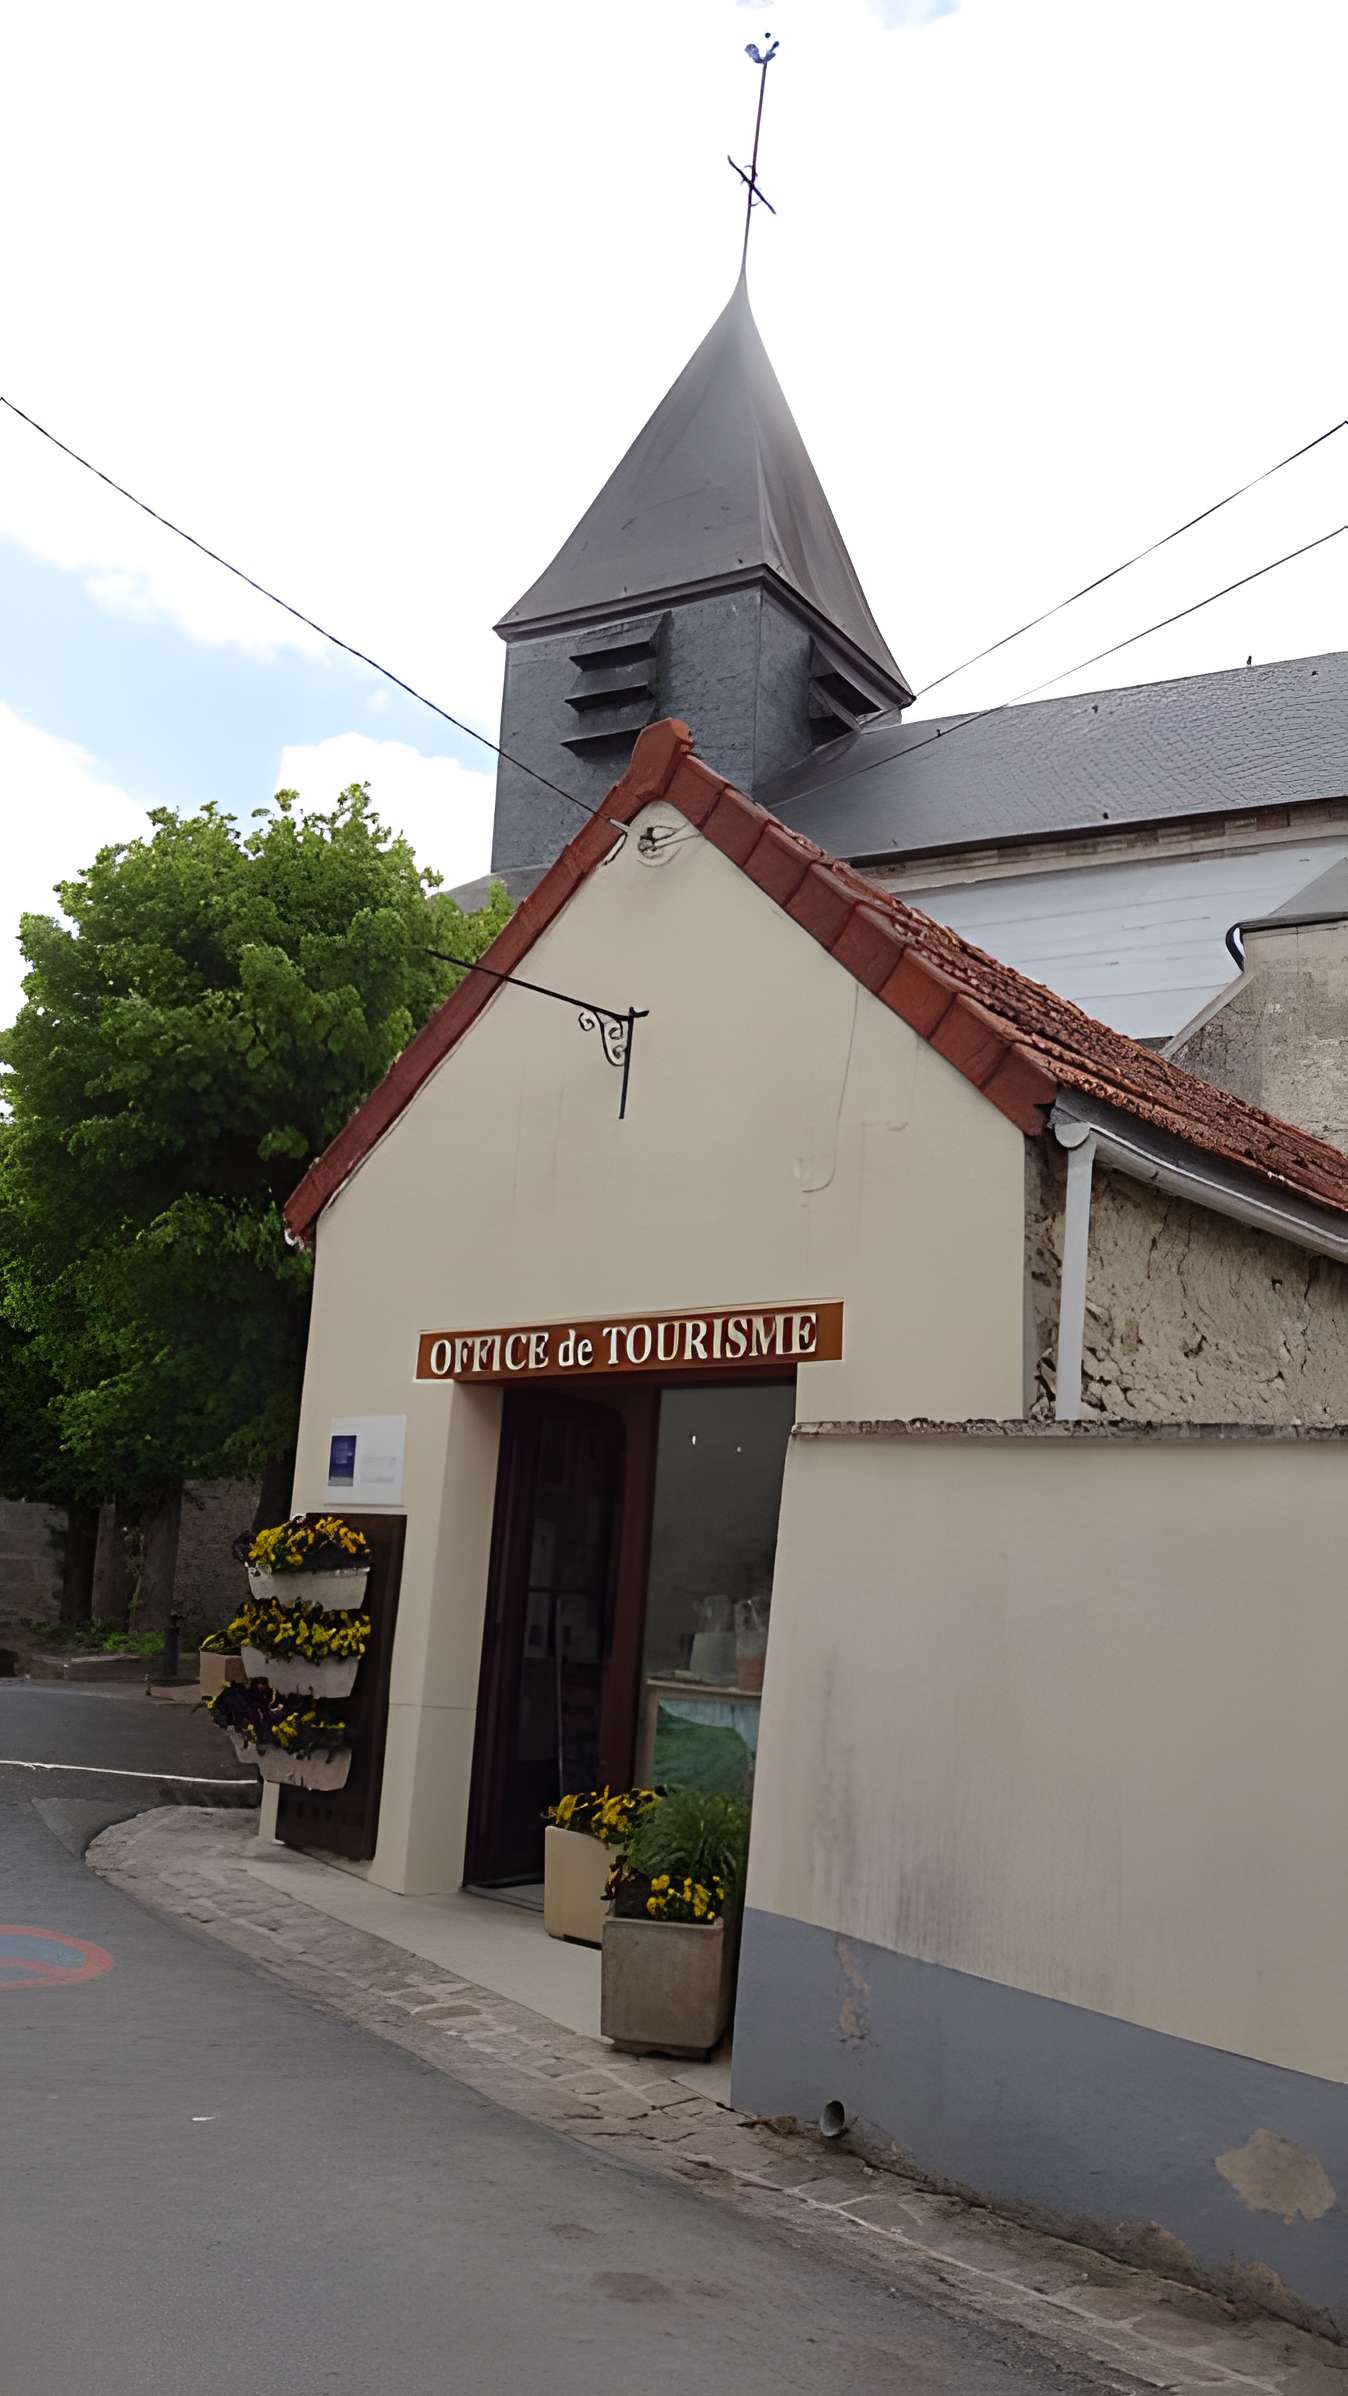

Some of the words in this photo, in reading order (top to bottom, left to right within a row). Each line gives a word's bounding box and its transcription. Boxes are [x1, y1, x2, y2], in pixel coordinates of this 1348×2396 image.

[429, 1331, 549, 1376] OFFICE
[558, 1328, 594, 1367] de
[602, 1311, 817, 1365] TOURISME
